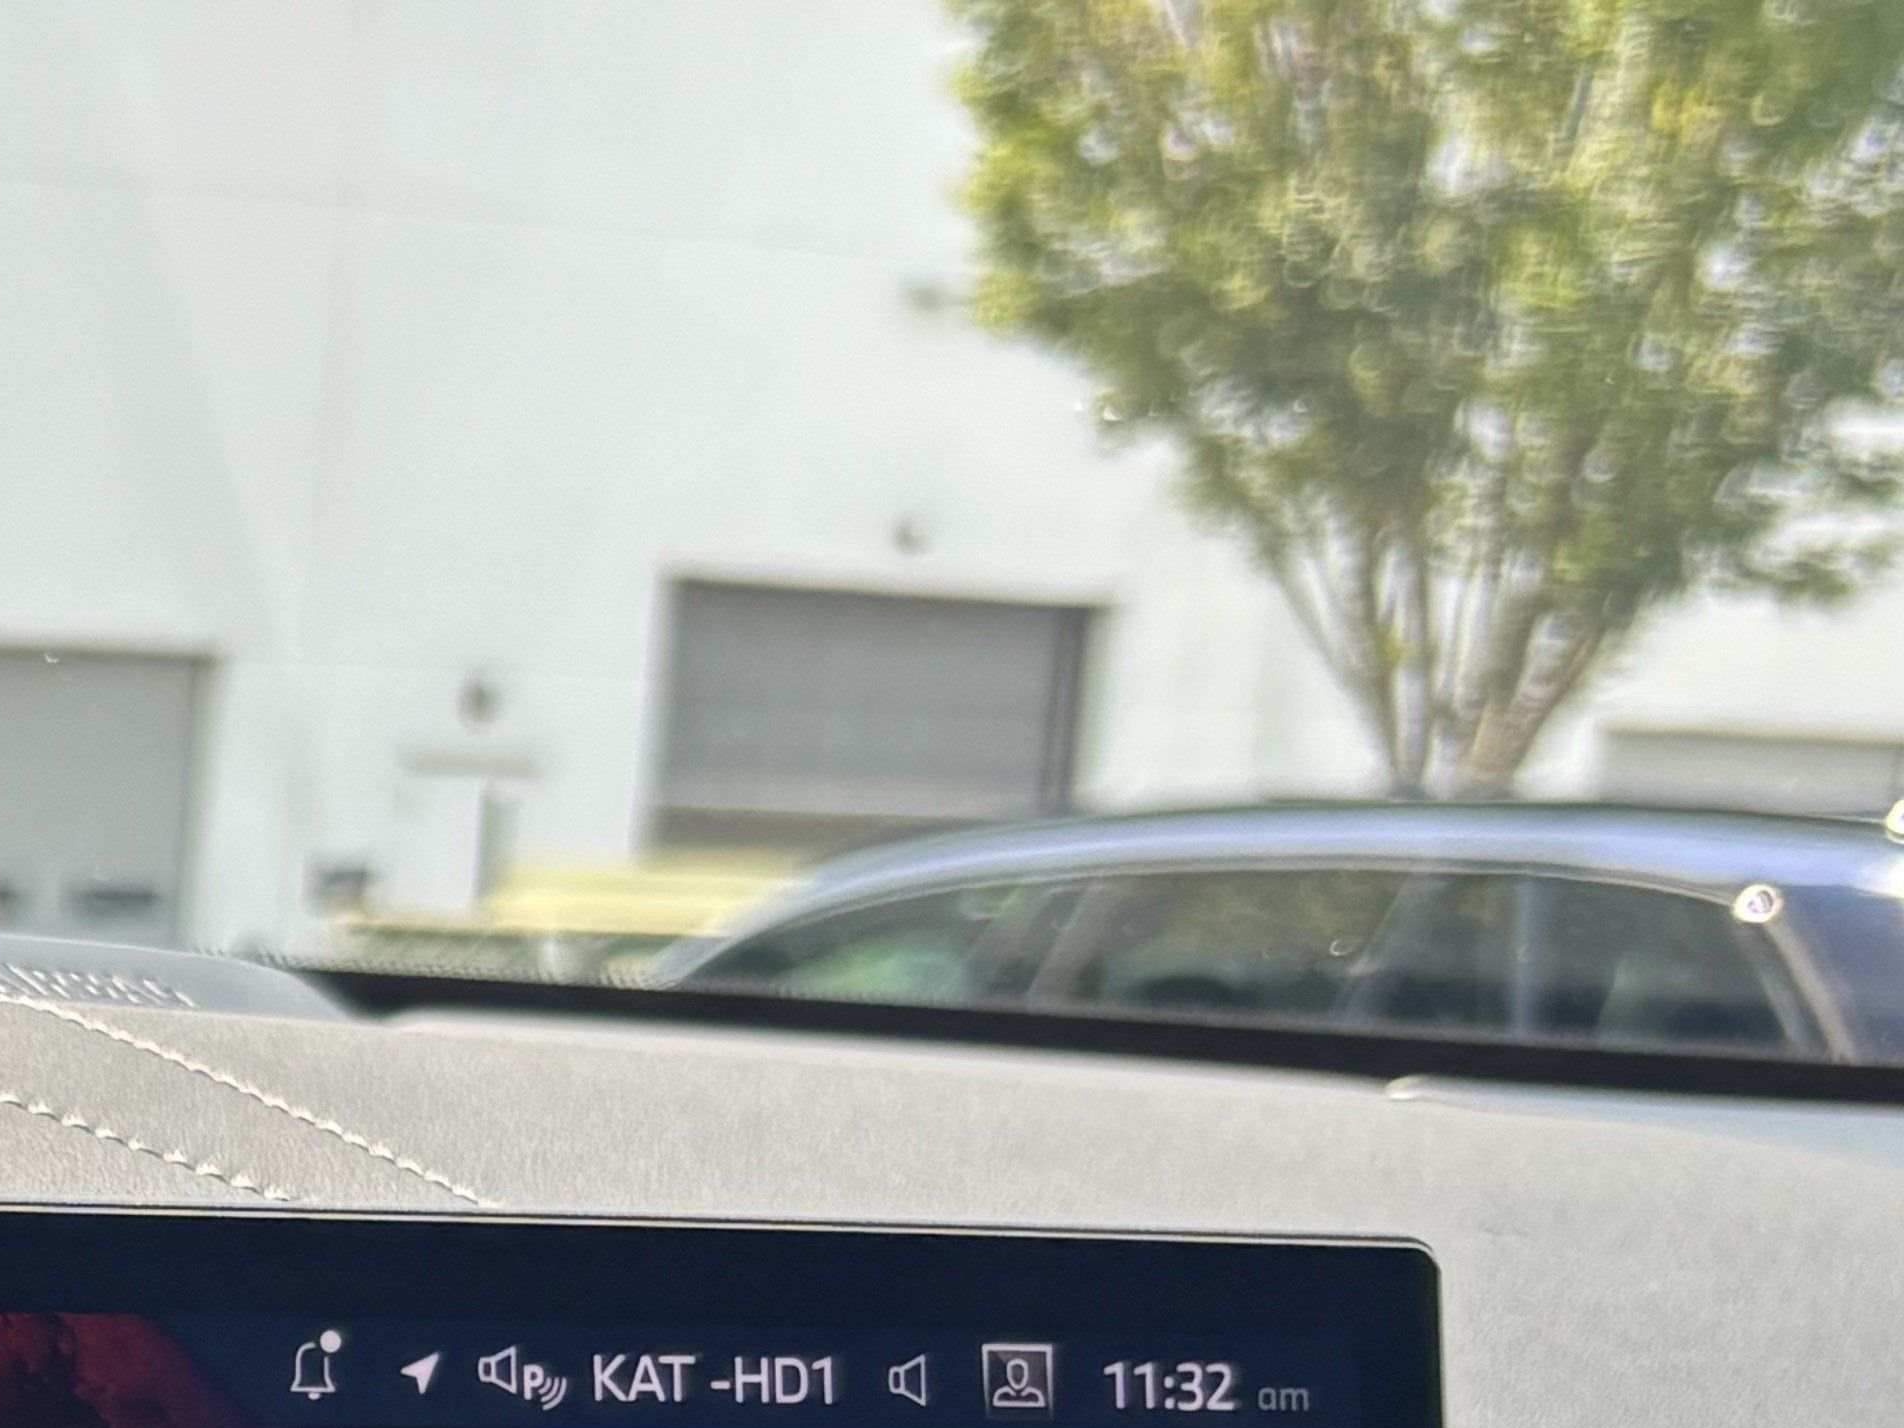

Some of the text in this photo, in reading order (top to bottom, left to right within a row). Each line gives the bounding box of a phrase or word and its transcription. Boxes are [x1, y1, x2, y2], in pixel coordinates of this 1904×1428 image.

[593, 1354, 833, 1405] KAT -HD1
[1103, 1361, 1310, 1412] 11:32 am
